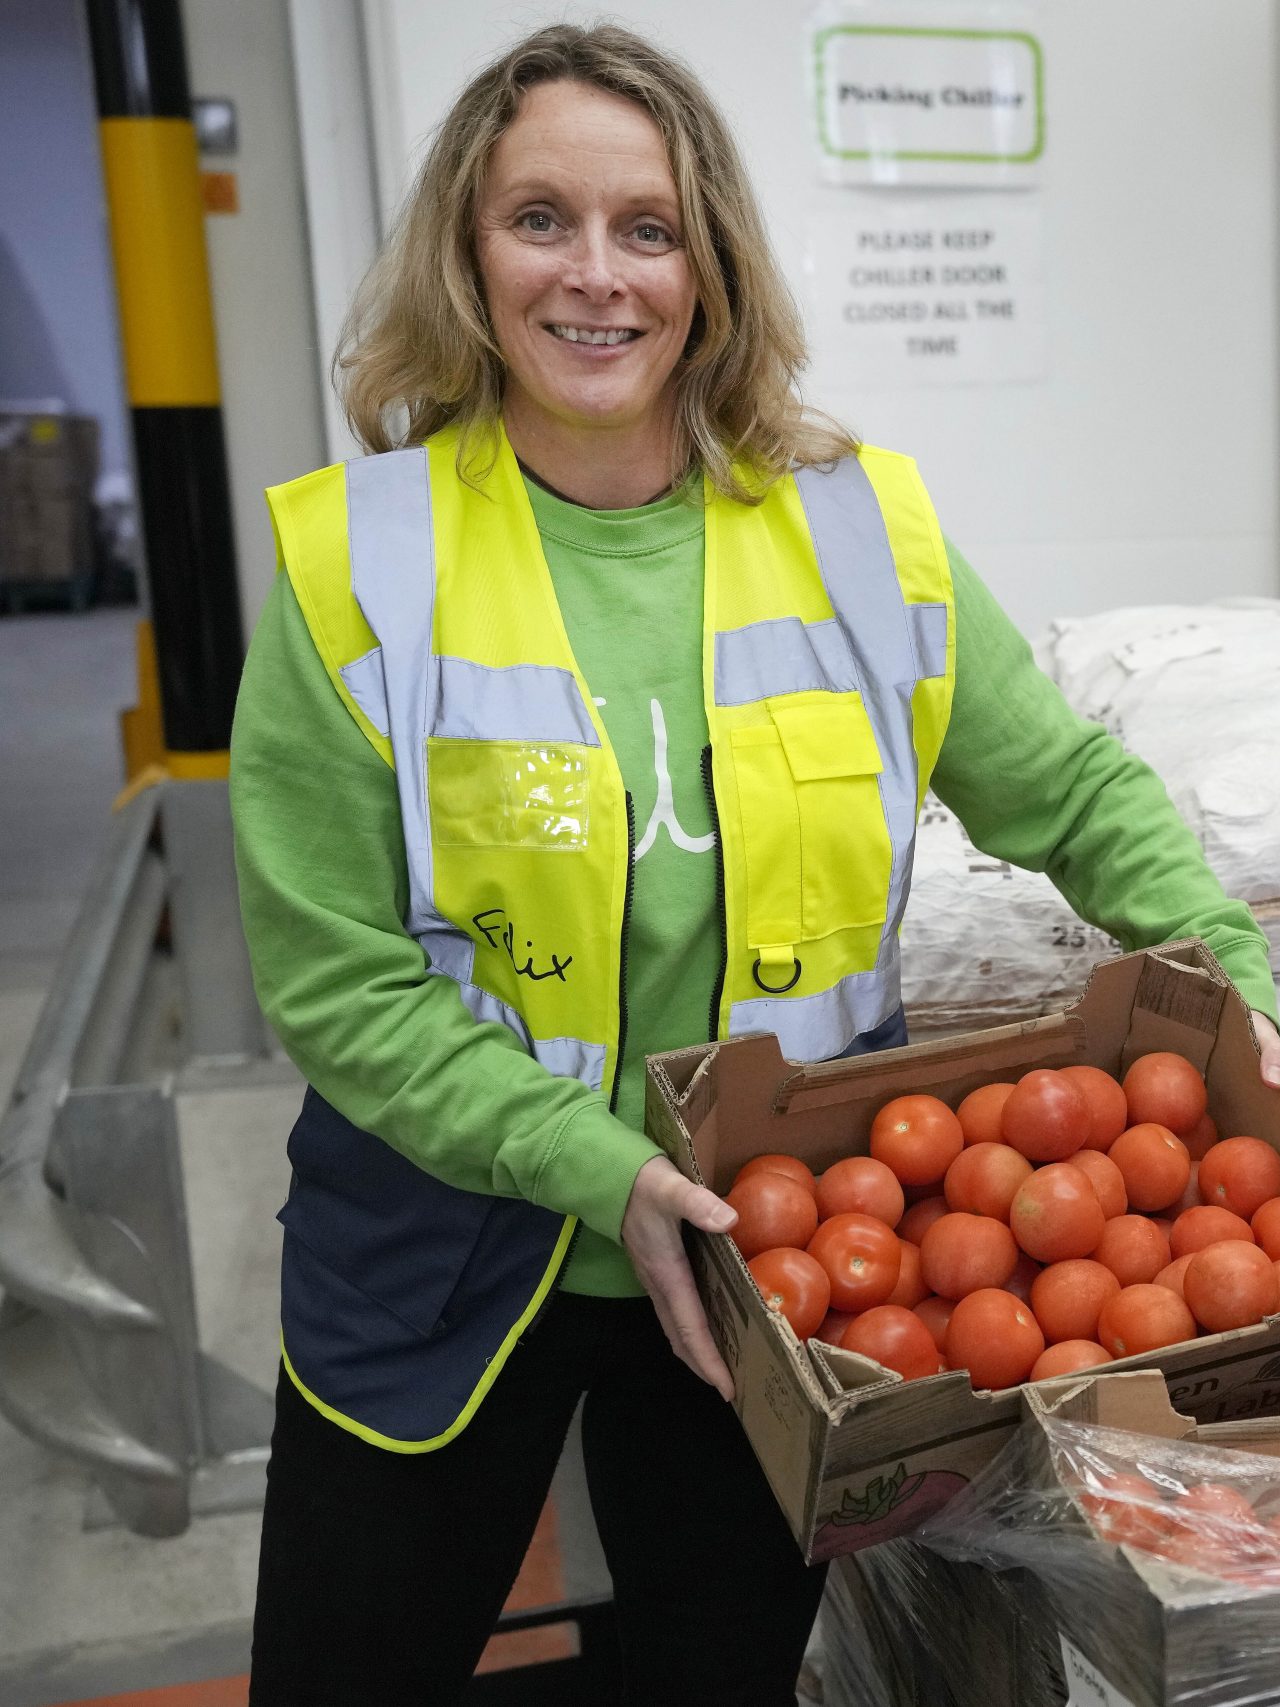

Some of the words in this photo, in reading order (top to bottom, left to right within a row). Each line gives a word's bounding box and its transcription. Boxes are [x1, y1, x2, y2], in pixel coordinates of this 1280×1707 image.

[857, 230, 934, 250] PLEASE
[941, 229, 995, 249] KEEP
[849, 266, 935, 287] CHILLER
[941, 265, 1006, 286] DOOR
[843, 302, 928, 323] CLOSED
[933, 302, 968, 322] ALL
[975, 300, 1014, 321] THE
